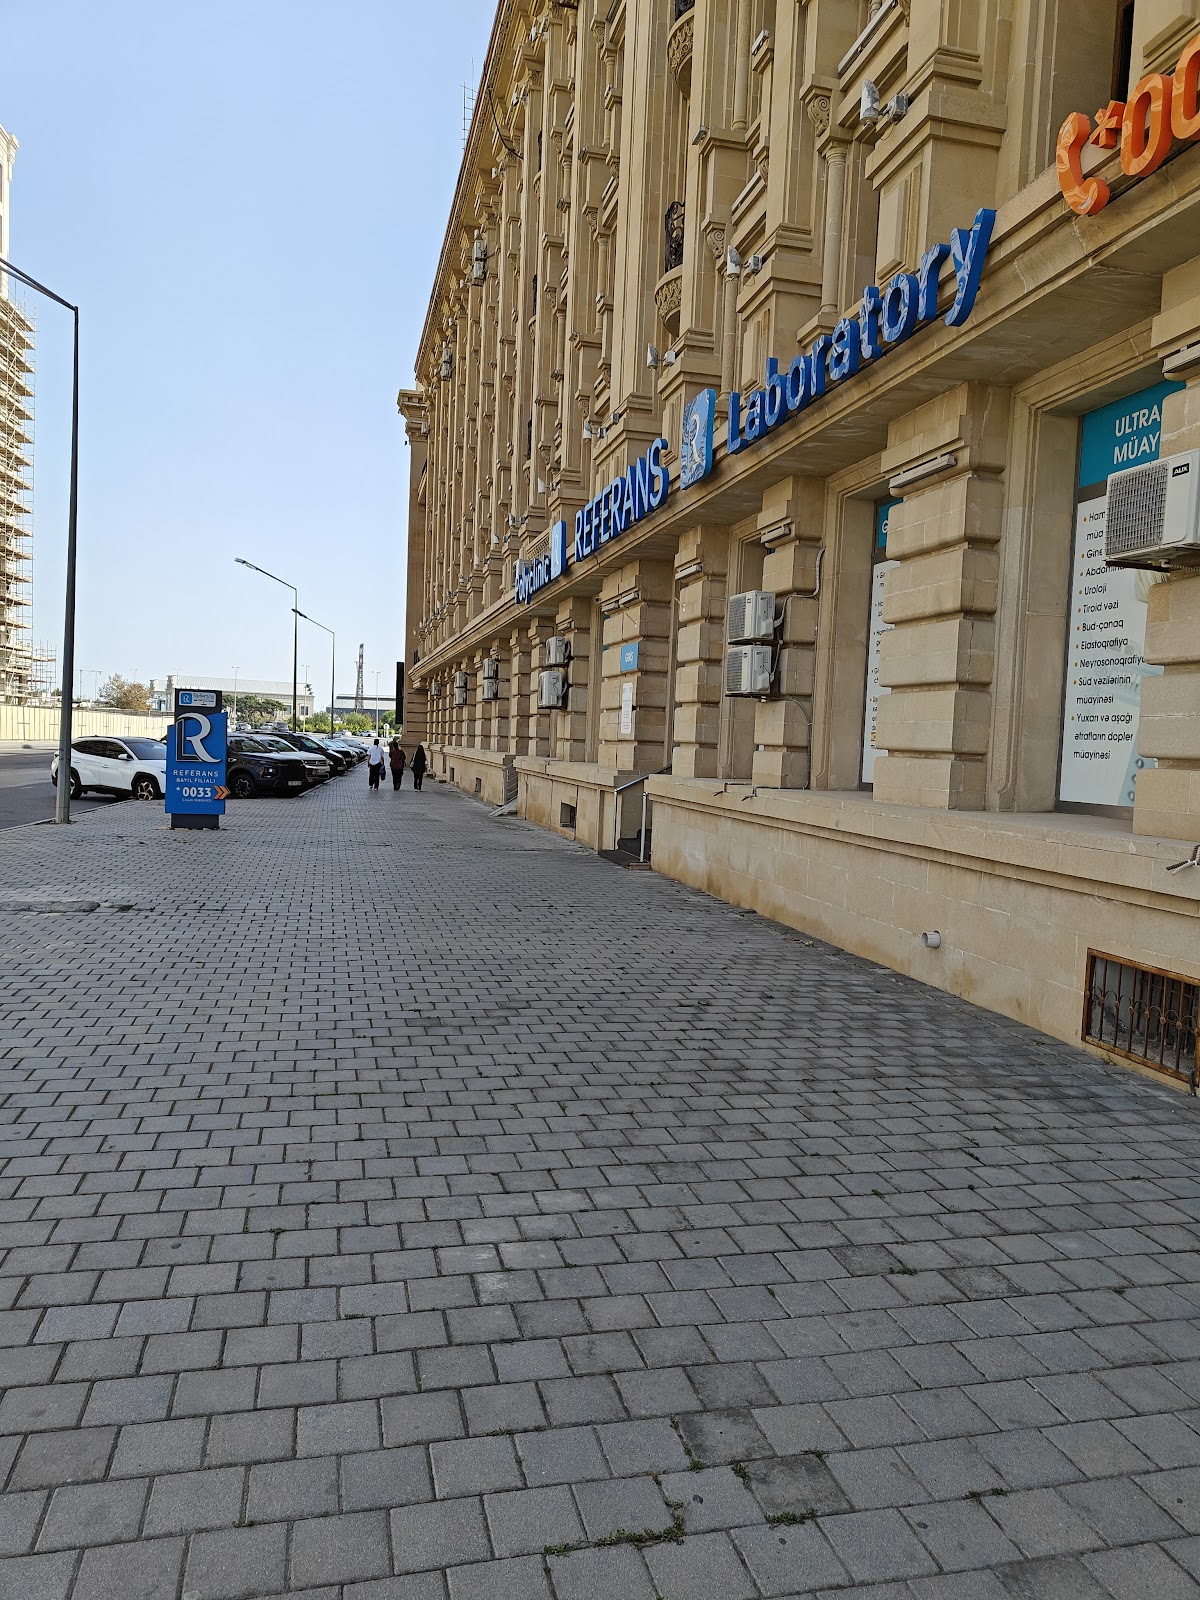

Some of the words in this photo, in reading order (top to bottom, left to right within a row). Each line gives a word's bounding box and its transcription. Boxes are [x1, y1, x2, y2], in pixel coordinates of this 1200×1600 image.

[515, 553, 551, 605] Polyclinic
[574, 437, 669, 563] REFERANS
[727, 208, 996, 455] Laboratory
[1115, 404, 1160, 437] ULTRA
[1113, 431, 1160, 465] MÜAY
[1173, 465, 1188, 475] AUX
[1084, 583, 1107, 595] Uroloji
[1083, 603, 1102, 614] Tiroid
[1103, 600, 1119, 610] vəzi
[1082, 619, 1124, 632] Bud-çanaq
[1081, 637, 1128, 650] Elastoqrafiya
[1078, 677, 1091, 686] Süd
[1093, 675, 1131, 686] vəzilərinin
[1076, 694, 1114, 705] müayinəsi
[1076, 713, 1099, 723] Yuxarı
[1100, 714, 1109, 722] və
[1111, 712, 1133, 724] aşağı
[1074, 732, 1106, 741] ətrafların
[1107, 731, 1133, 743] dopler
[1073, 750, 1111, 760] müayinəsi
[173, 769, 219, 777] REFERANS
